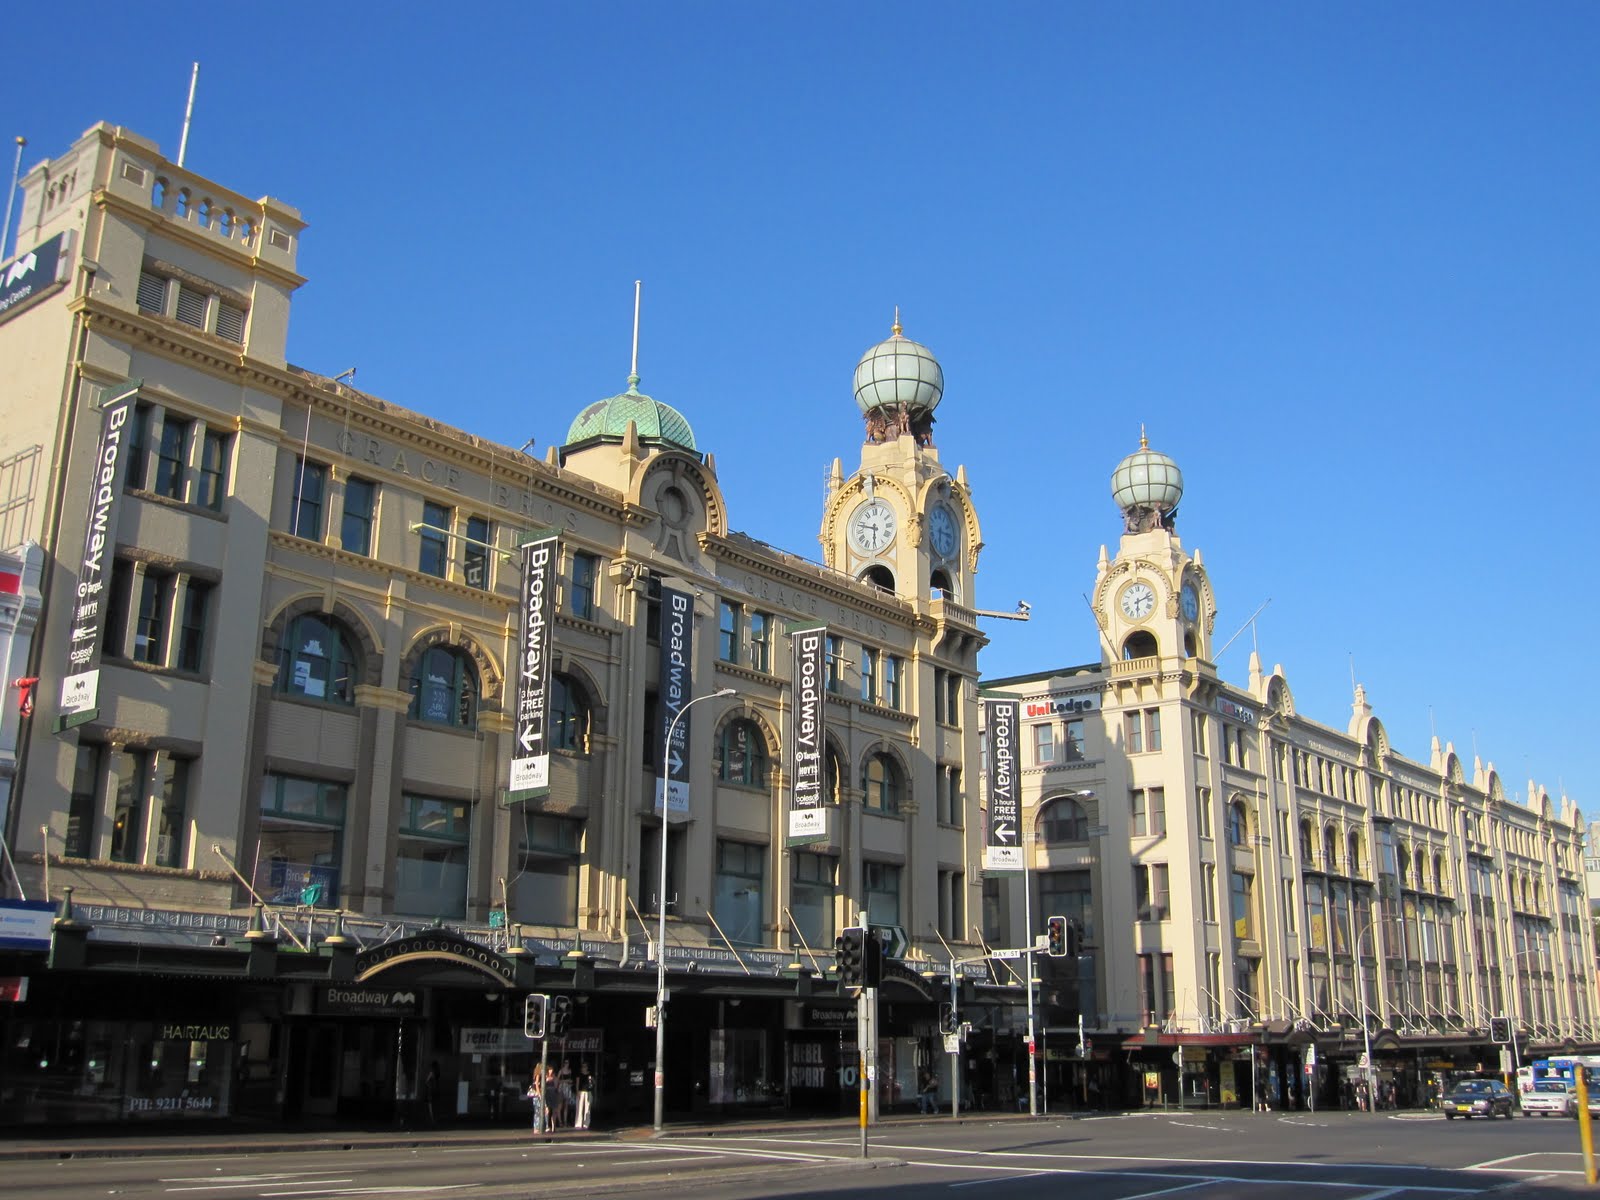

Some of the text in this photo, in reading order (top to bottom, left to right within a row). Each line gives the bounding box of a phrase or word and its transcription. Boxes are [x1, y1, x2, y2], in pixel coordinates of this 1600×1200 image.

[85, 405, 128, 571] Broadway
[336, 431, 579, 532] GRACE BROS
[522, 548, 549, 681] Broadway
[744, 575, 888, 640] GRACE BROS
[664, 594, 687, 714] Broadway
[521, 688, 544, 699] 3 hours
[798, 637, 818, 746] Broadway
[521, 698, 544, 711] FREE
[1027, 699, 1092, 717] UniLodge
[520, 710, 544, 722] parking
[669, 717, 686, 728] hurs
[664, 738, 685, 749] prking
[994, 705, 1013, 797] Broadway
[515, 772, 543, 782] Broadway
[994, 806, 1016, 814] FREE
[328, 988, 388, 1006] Broadway
[811, 1008, 845, 1022] Broadway
[163, 1025, 230, 1040] HAIRTALKS
[791, 1066, 826, 1088] SPORT
[156, 1096, 183, 1110] 9211
[185, 1096, 213, 1110] 5644
